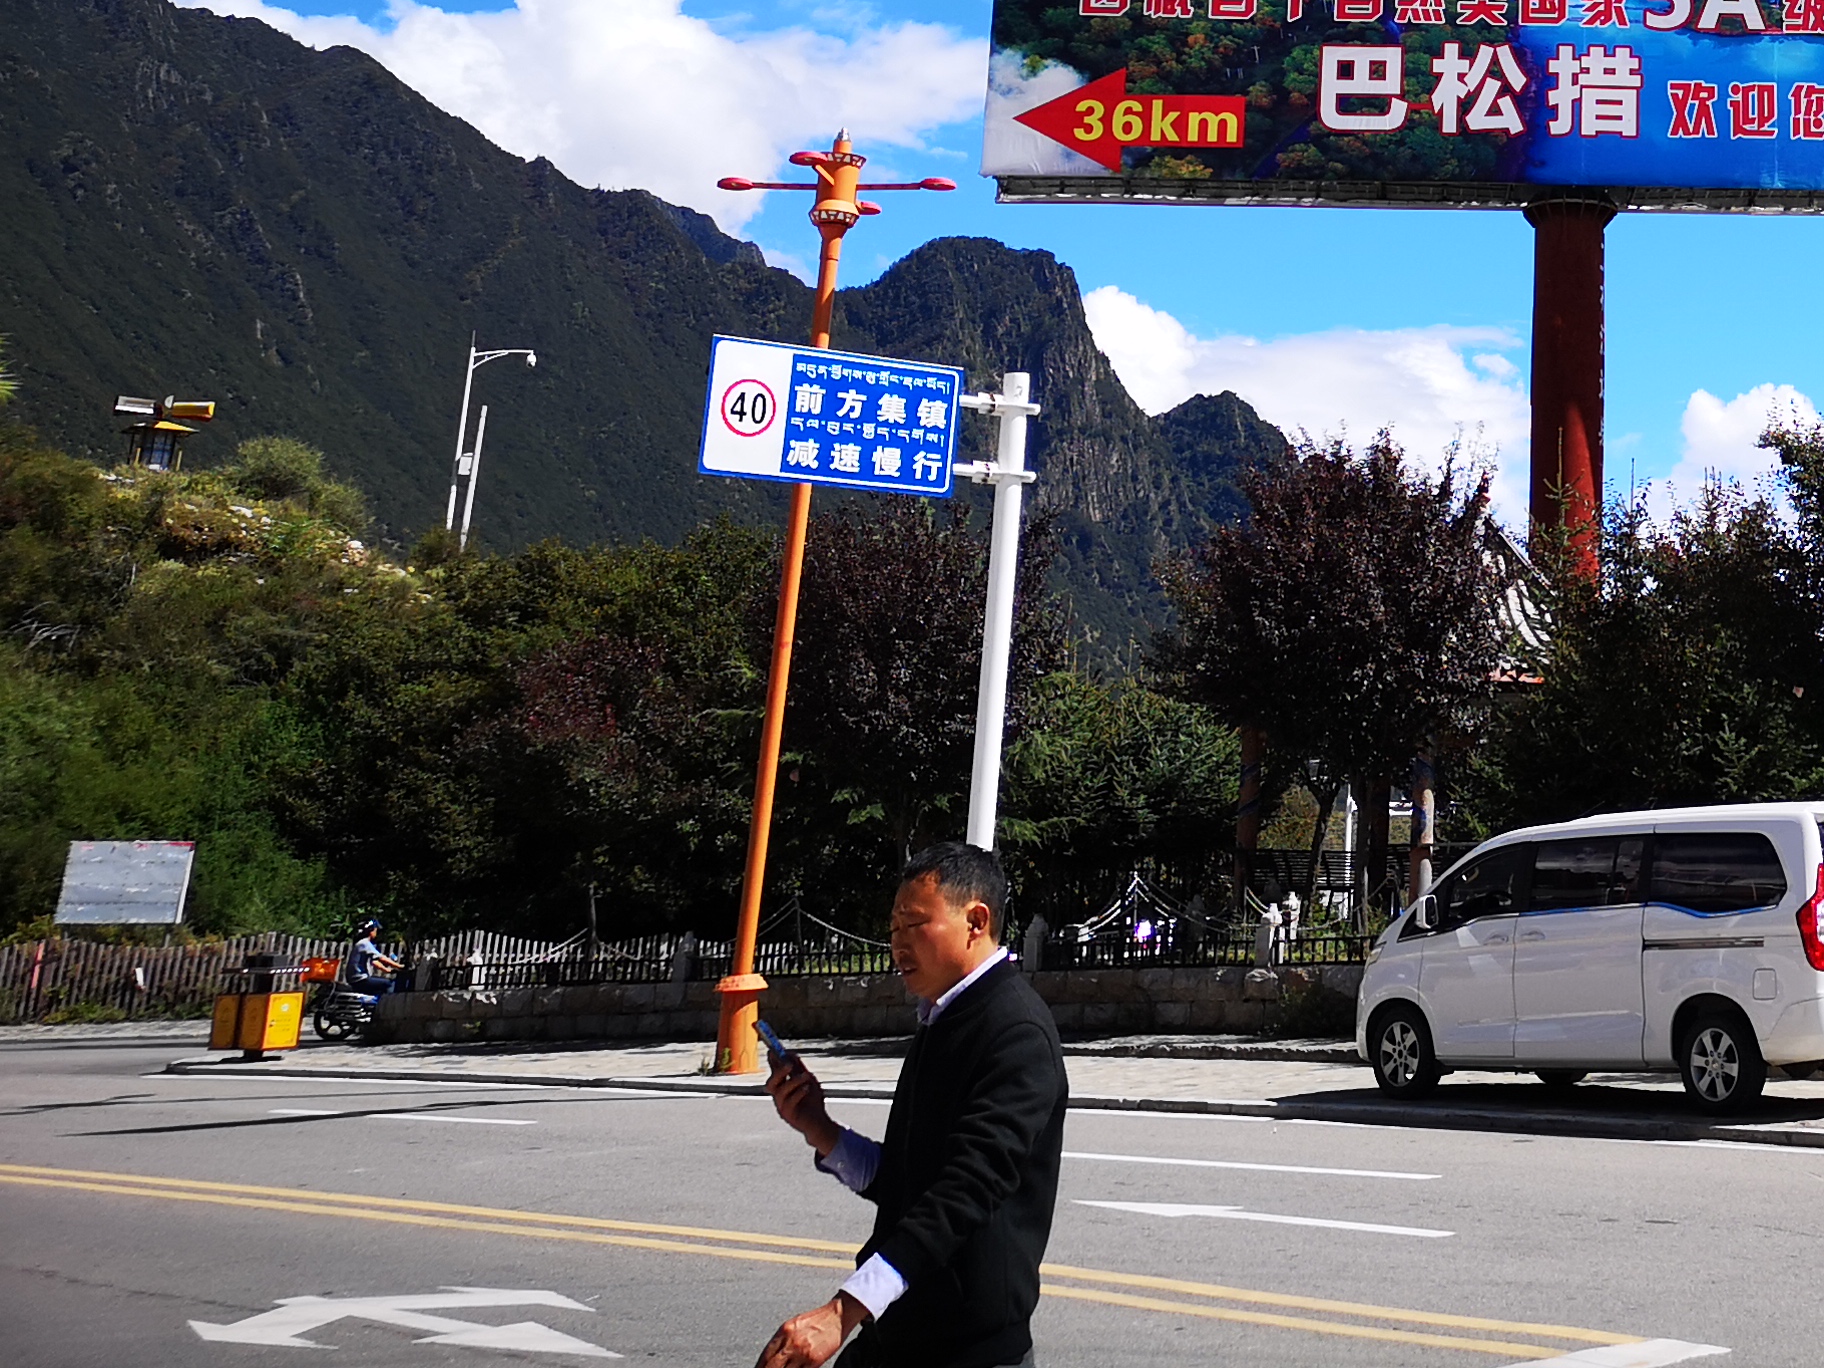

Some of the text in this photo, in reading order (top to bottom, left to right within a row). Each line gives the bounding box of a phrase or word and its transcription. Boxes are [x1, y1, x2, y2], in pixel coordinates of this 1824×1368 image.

[1319, 42, 1644, 138] 巴松措
[1073, 99, 1239, 143] 36km
[730, 392, 767, 424] 40
[794, 383, 949, 429] 前方集镇
[787, 438, 943, 482] 减速慢行
